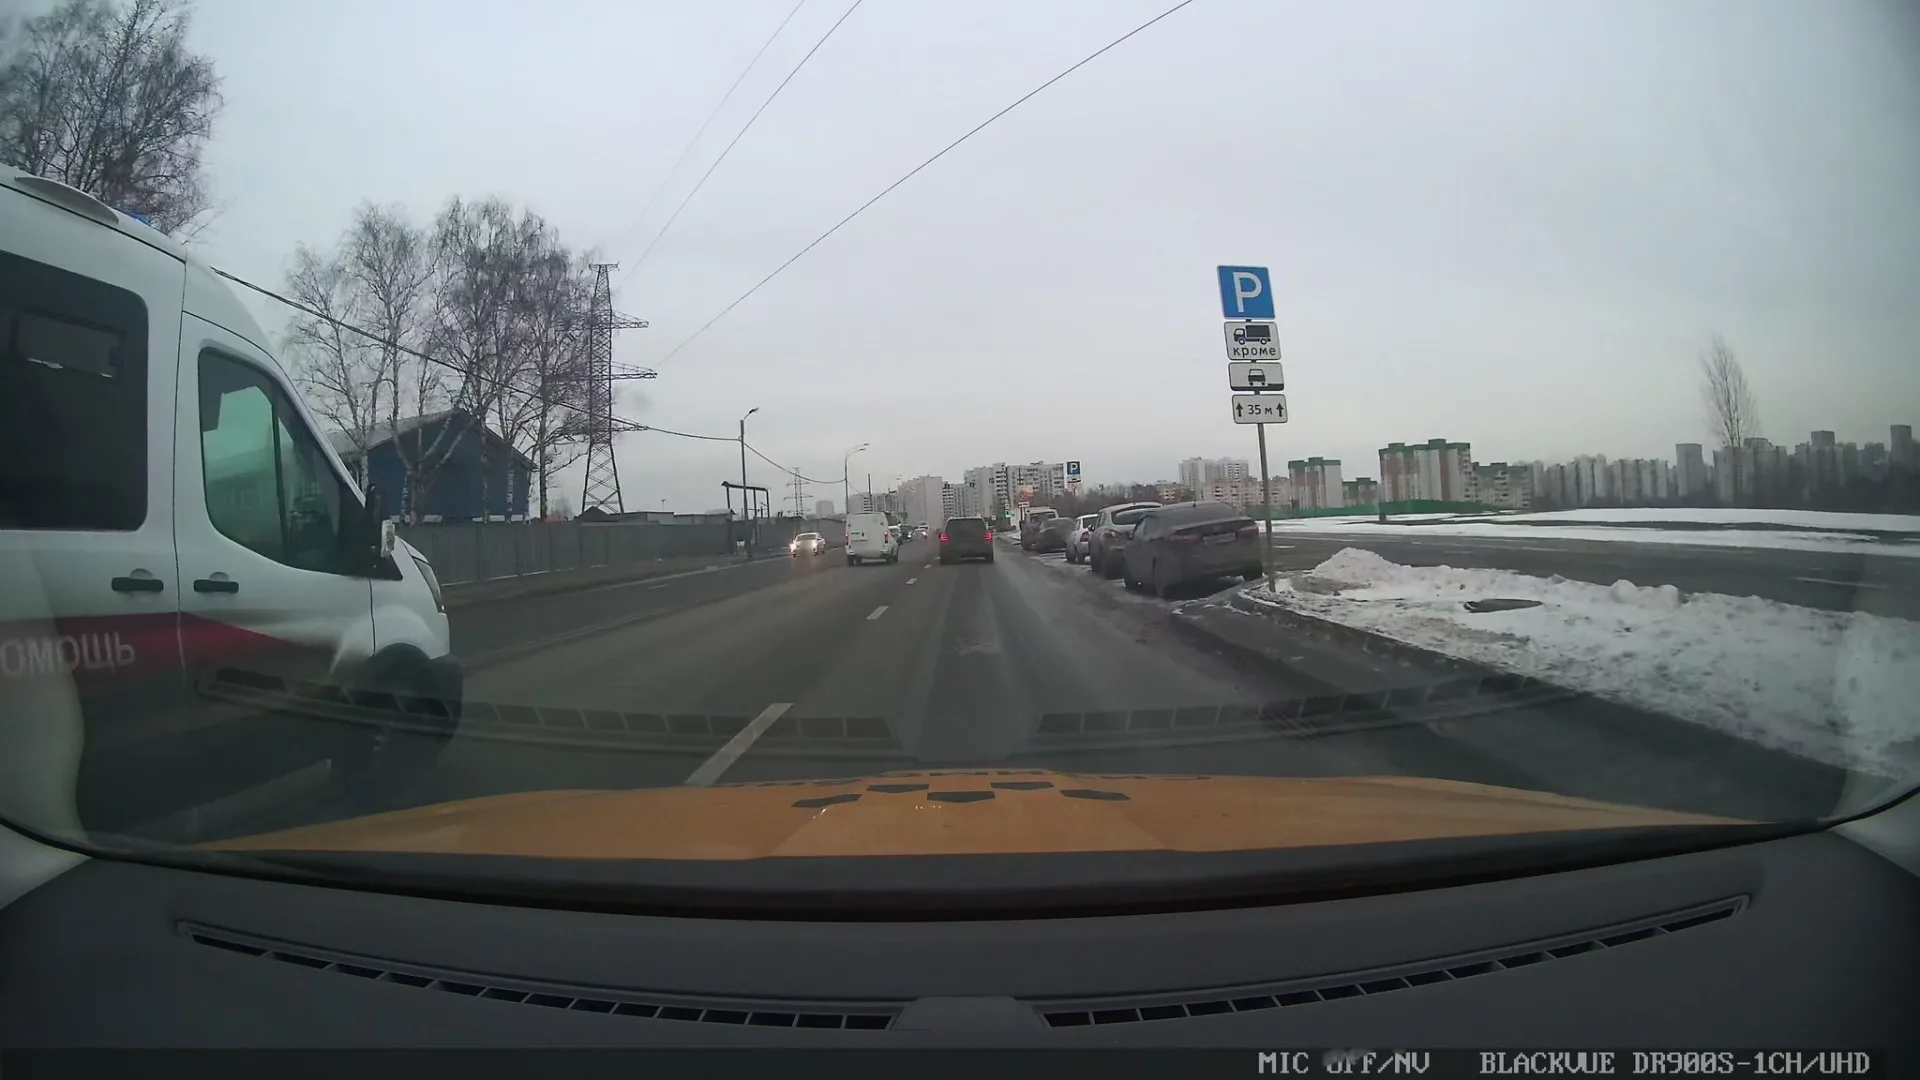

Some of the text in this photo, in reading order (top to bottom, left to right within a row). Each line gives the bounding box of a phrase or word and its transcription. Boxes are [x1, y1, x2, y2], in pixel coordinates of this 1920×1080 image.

[1232, 271, 1262, 313] P
[1233, 346, 1276, 358] кроме
[1247, 404, 1262, 415] 35
[1070, 463, 1078, 473] P
